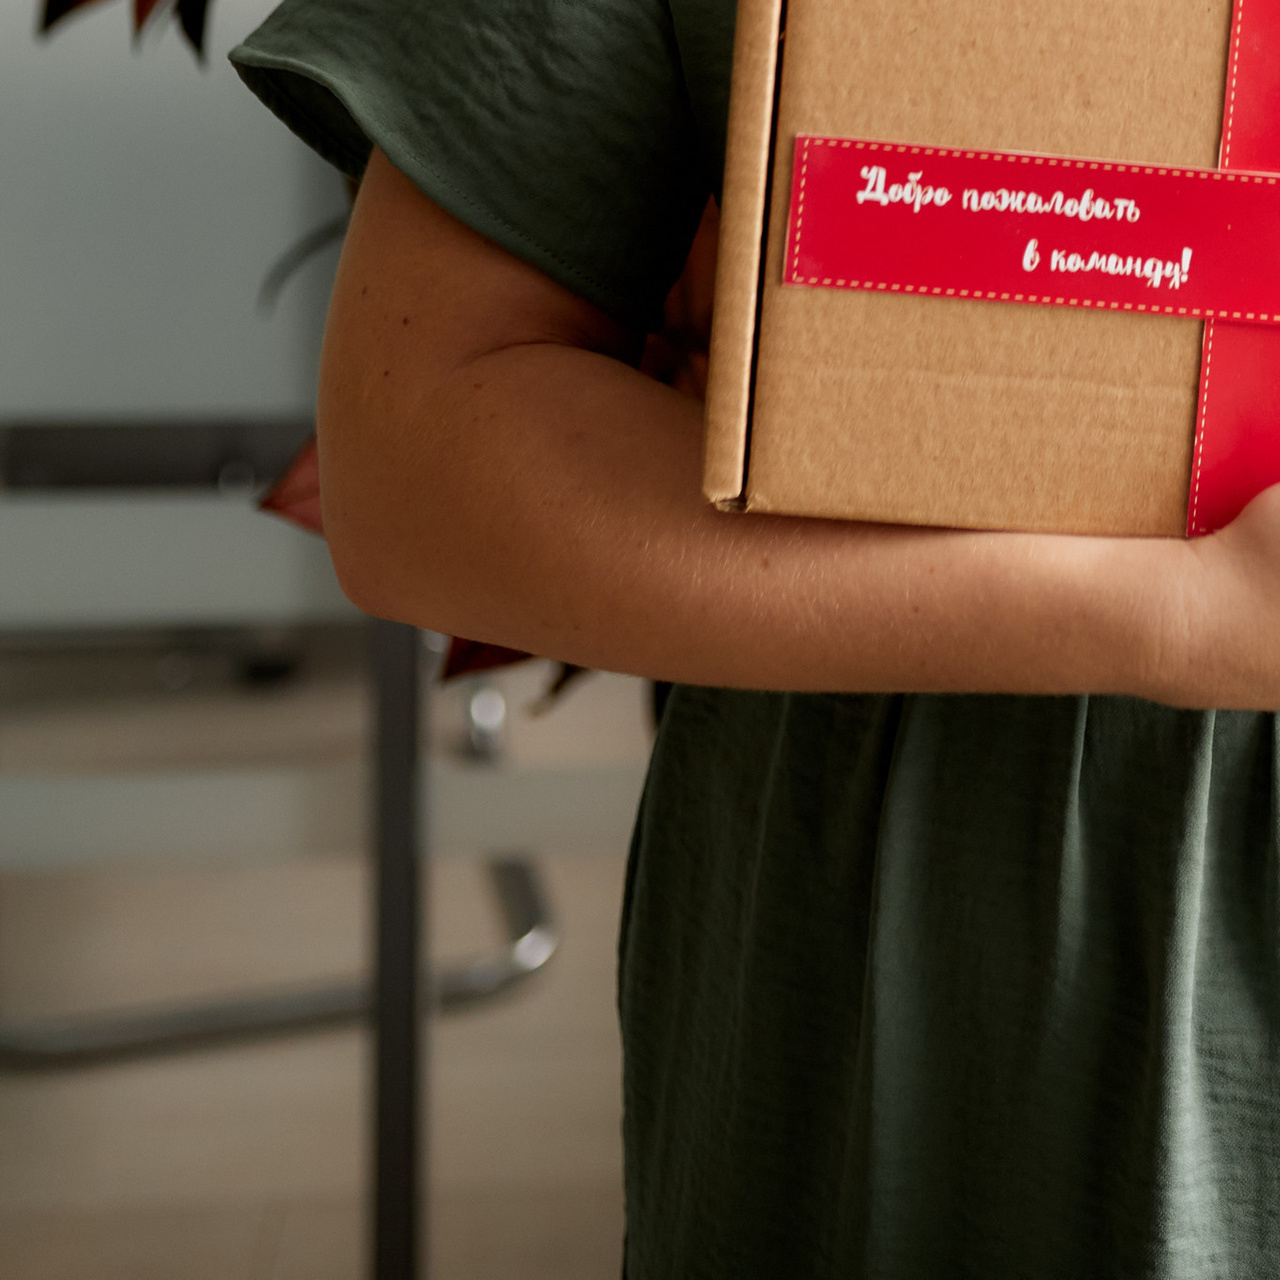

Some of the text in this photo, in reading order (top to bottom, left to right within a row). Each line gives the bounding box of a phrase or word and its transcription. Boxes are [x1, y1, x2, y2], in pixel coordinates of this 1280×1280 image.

[856, 165, 1141, 223] Добро пожаловать
[1022, 238, 1193, 290] в команду!
